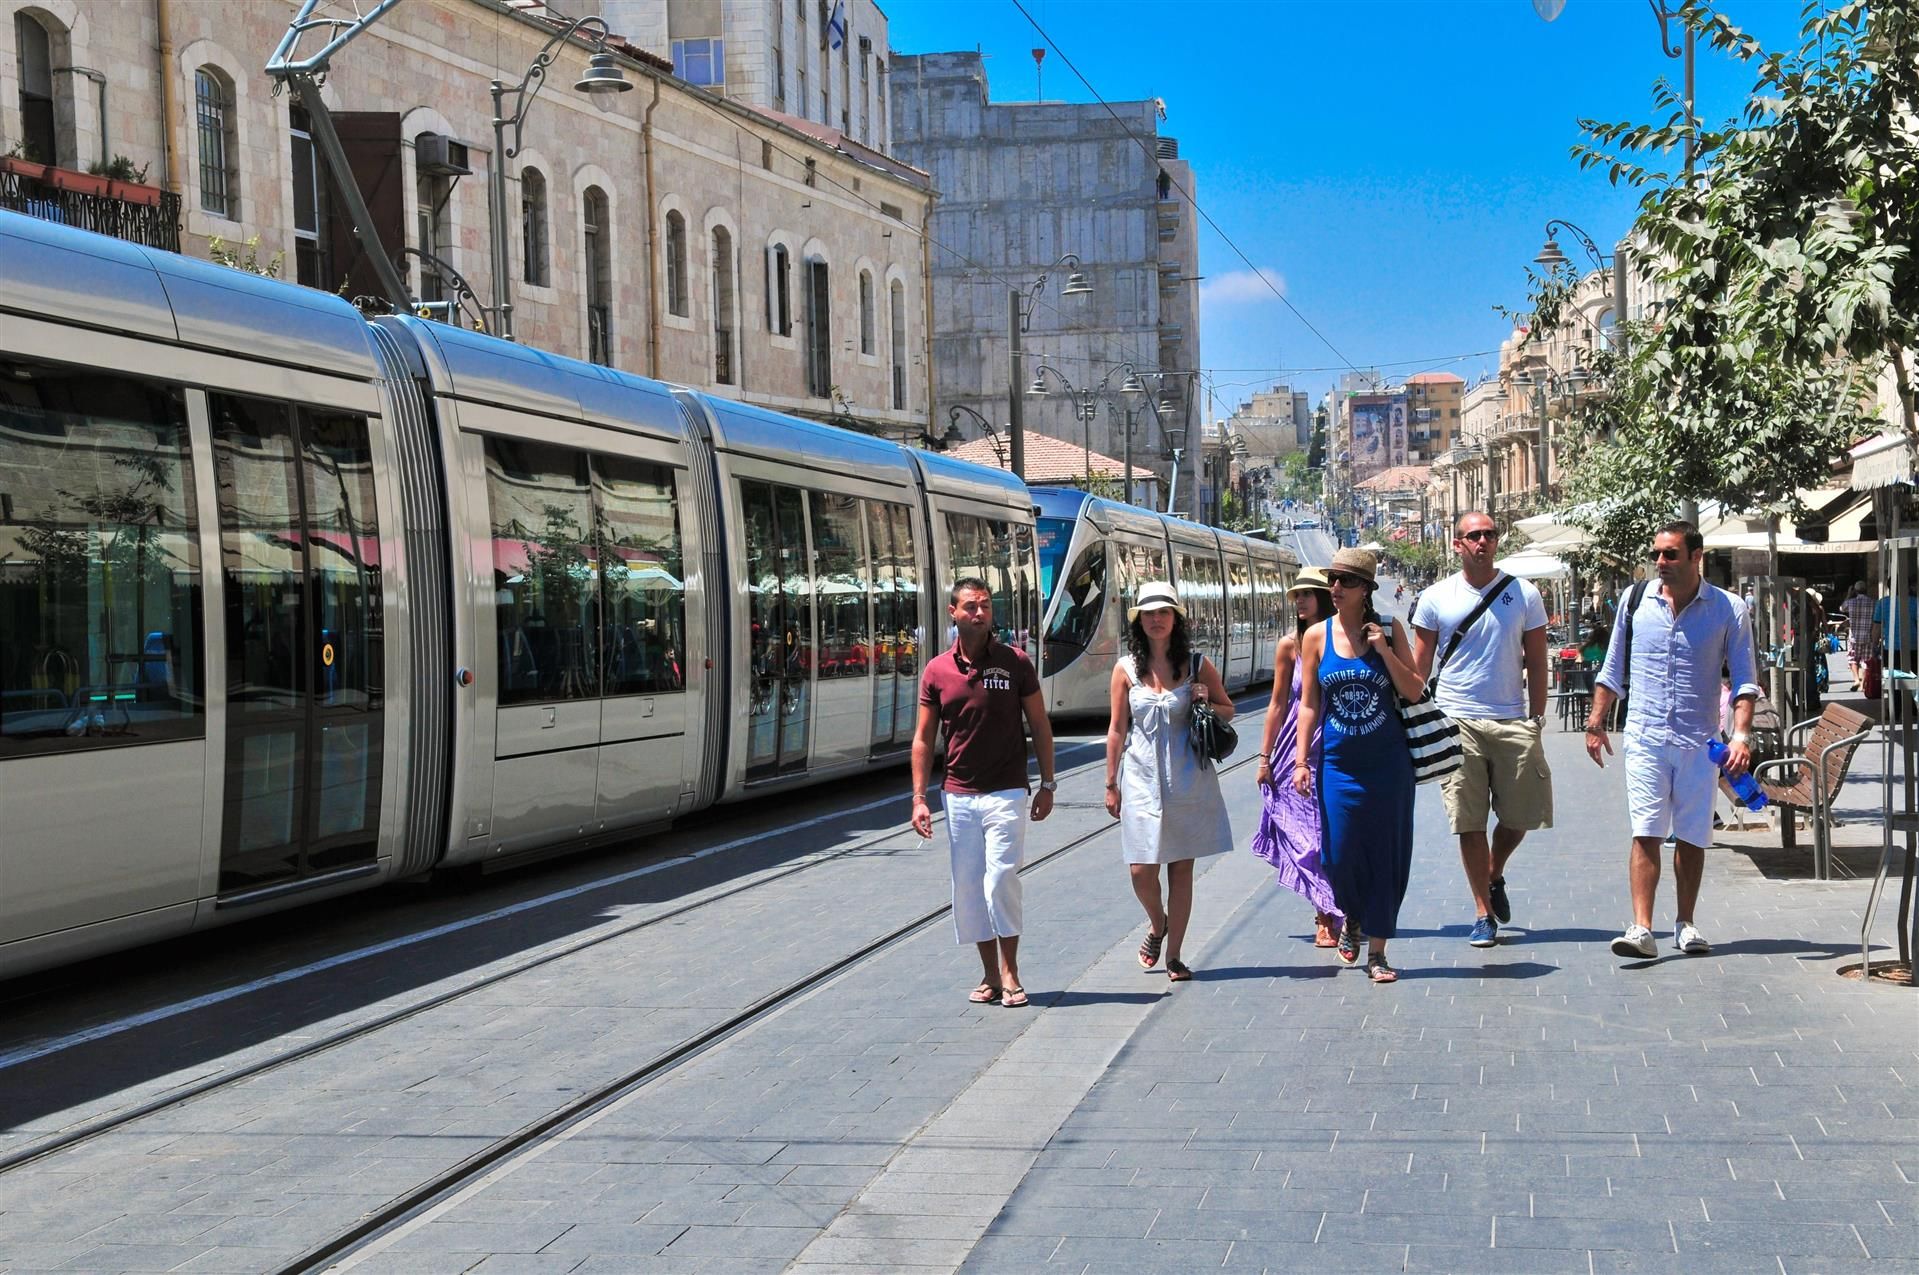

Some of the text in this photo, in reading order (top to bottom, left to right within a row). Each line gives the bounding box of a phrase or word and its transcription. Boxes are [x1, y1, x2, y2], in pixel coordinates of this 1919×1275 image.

[983, 678, 1010, 690] FITCH
[1320, 669, 1356, 688] NSTITUTE
[1359, 669, 1372, 681] OF
[1349, 725, 1358, 736] OF
[1359, 709, 1388, 735] HARMONY
